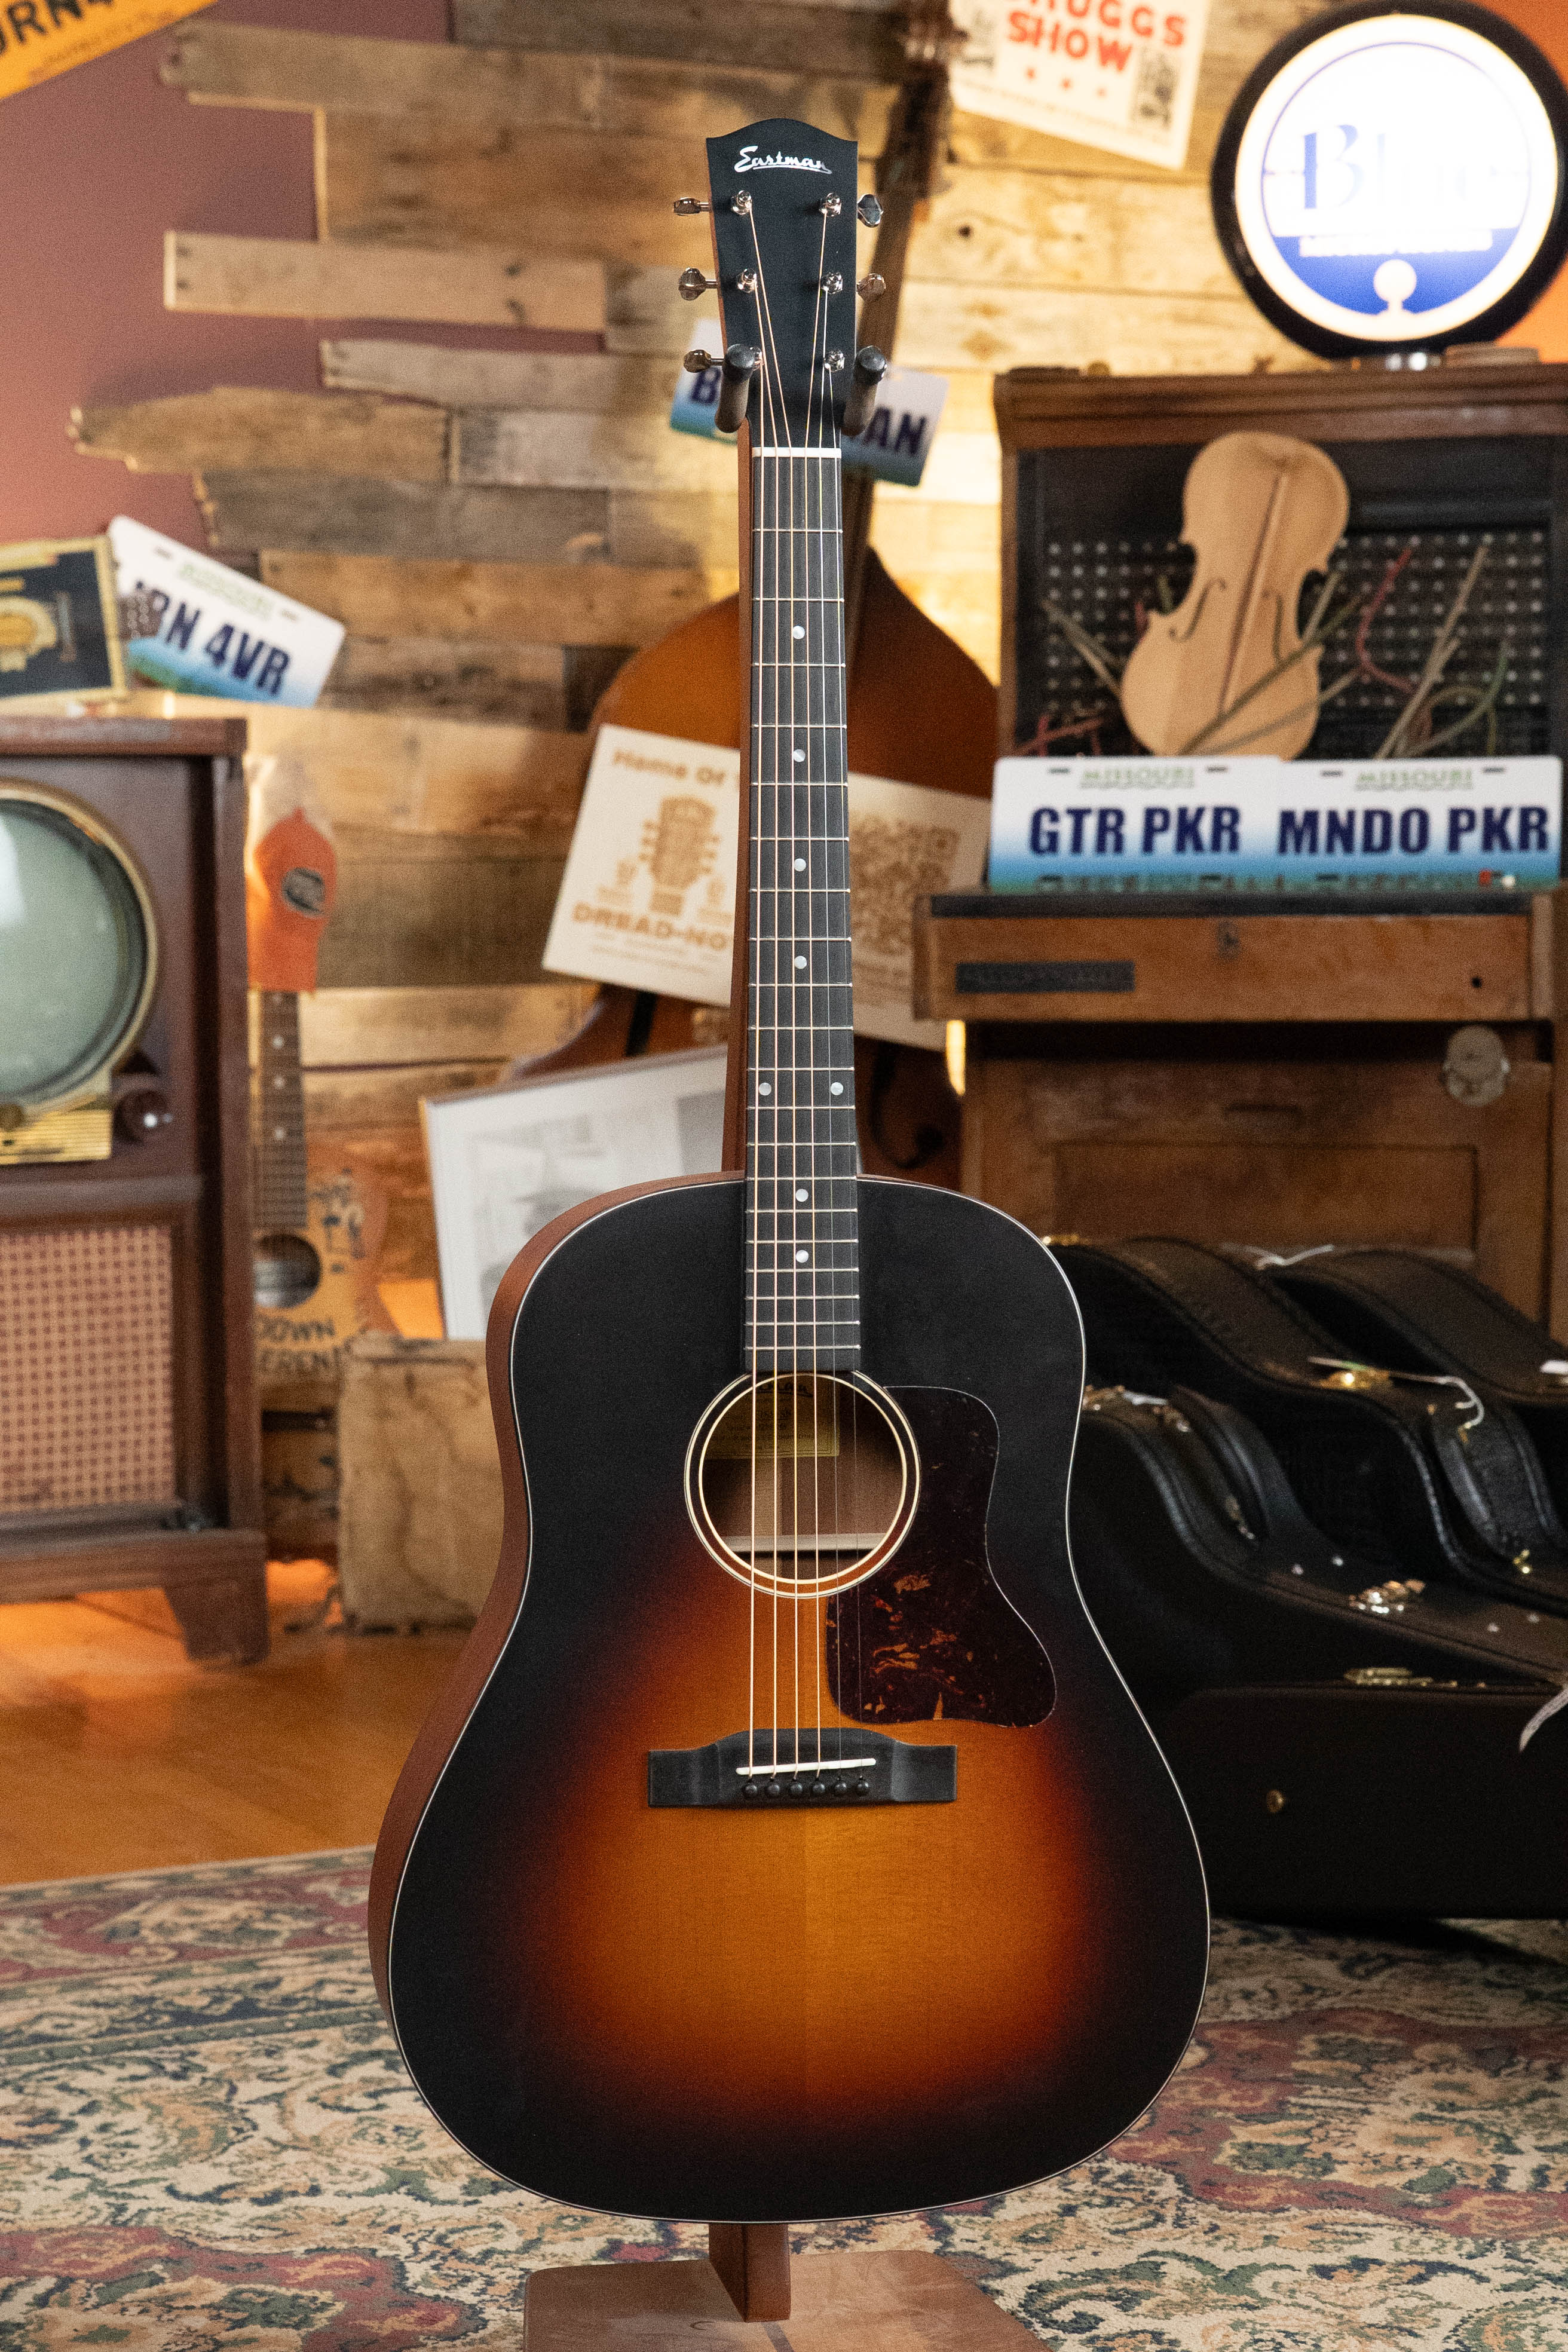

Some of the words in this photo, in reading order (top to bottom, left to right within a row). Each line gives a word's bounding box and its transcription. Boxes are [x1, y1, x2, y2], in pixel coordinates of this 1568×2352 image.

[1007, 11, 1132, 73] SHOW
[734, 145, 832, 175] Eastman
[204, 623, 292, 697] 4VR
[1030, 806, 1126, 856] GTR
[1141, 805, 1242, 855] PKR
[1277, 807, 1430, 855] MNDO
[1447, 806, 1549, 853] PKR
[572, 902, 731, 951] DREAD-NO
